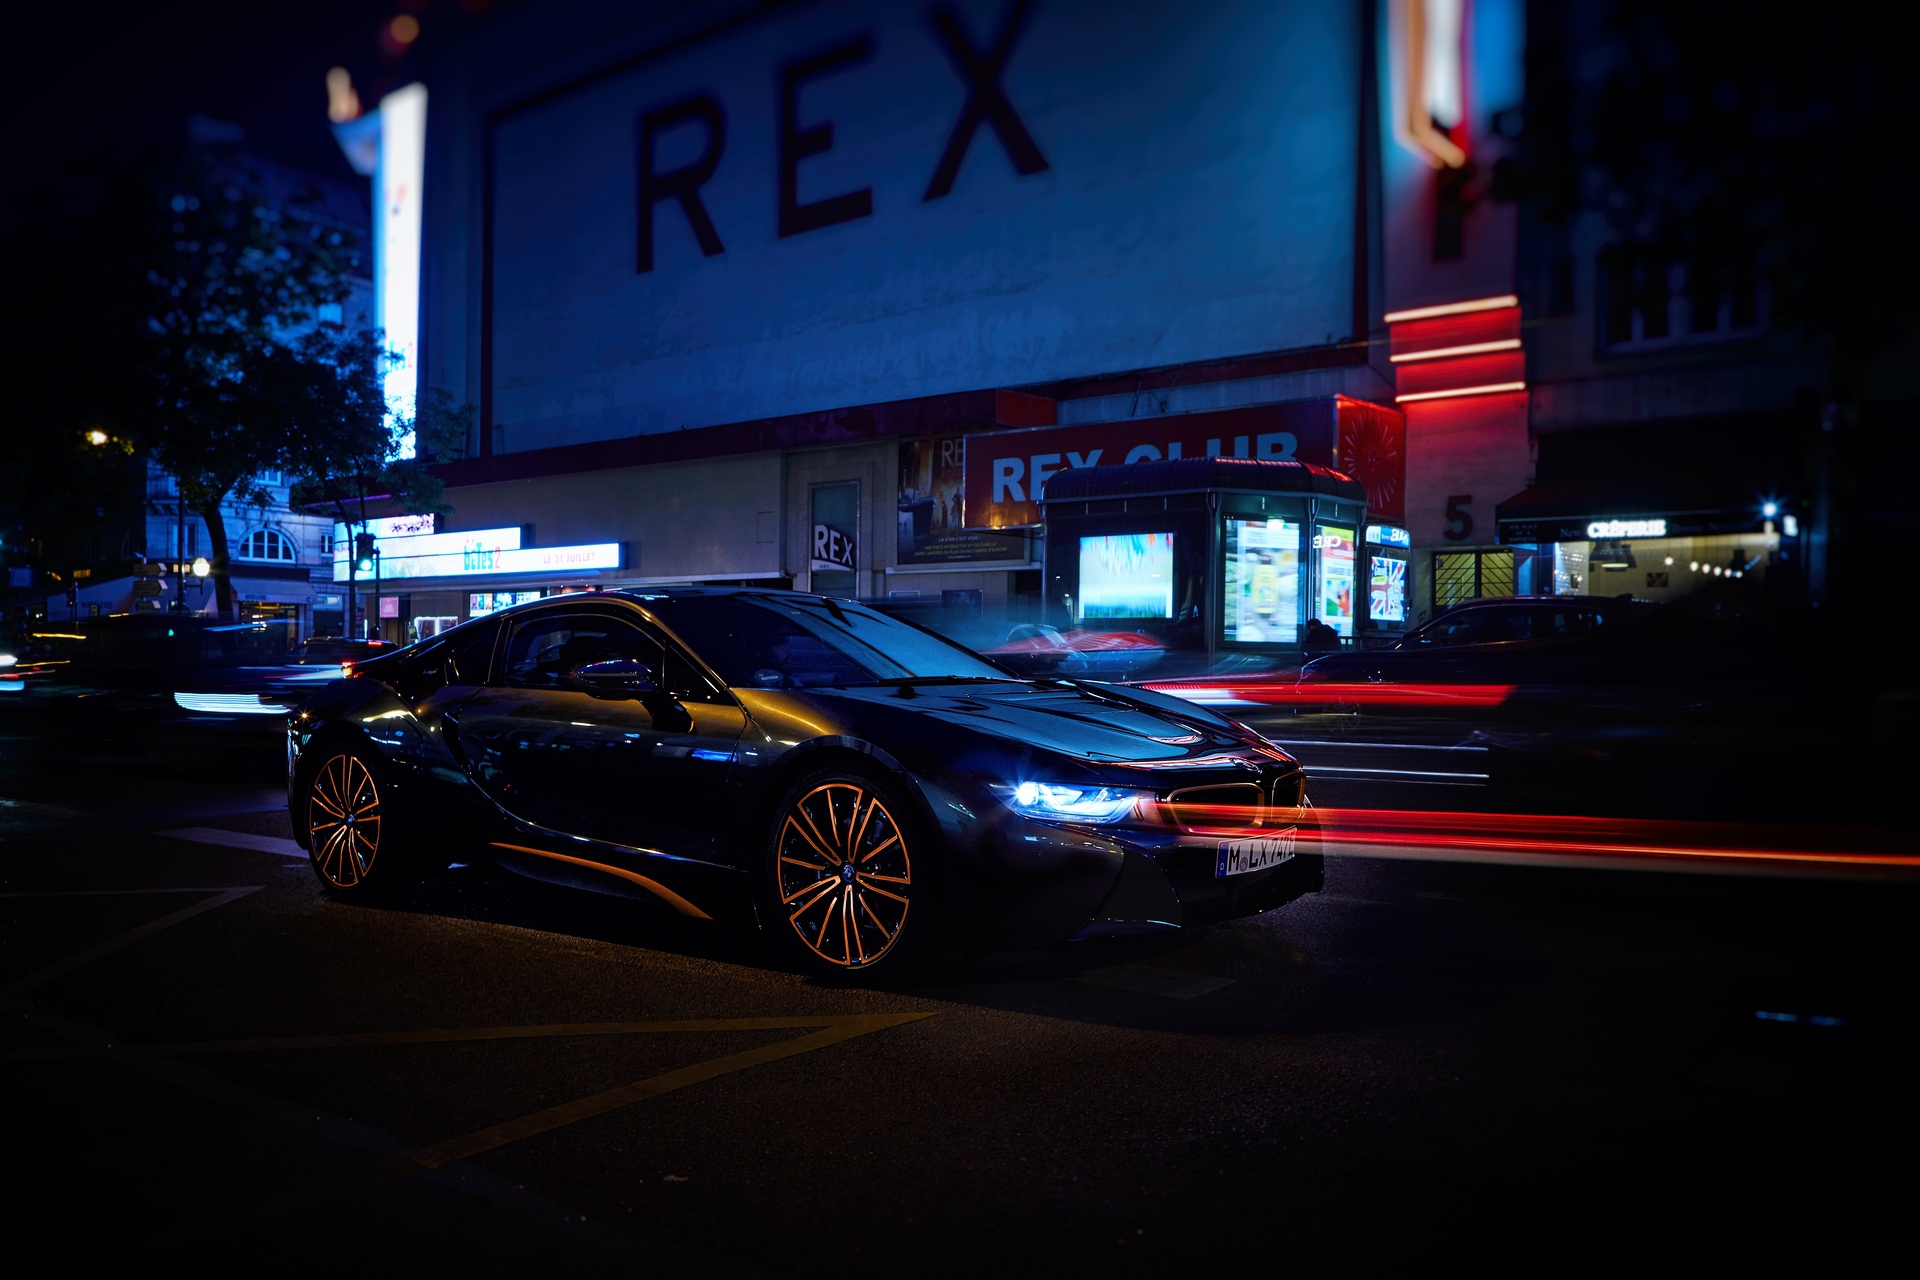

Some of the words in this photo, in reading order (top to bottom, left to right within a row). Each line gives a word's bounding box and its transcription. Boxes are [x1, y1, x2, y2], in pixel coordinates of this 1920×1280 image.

[634, 0, 1049, 273] REX
[941, 438, 963, 467] RE
[1443, 494, 1473, 540] 5
[544, 555, 551, 564] LE
[554, 554, 563, 564] 31
[565, 552, 595, 563] JUILLET
[814, 525, 853, 566] REX
[173, 563, 190, 573] BR
[1228, 845, 1241, 872] M
[1249, 840, 1267, 868] LX
